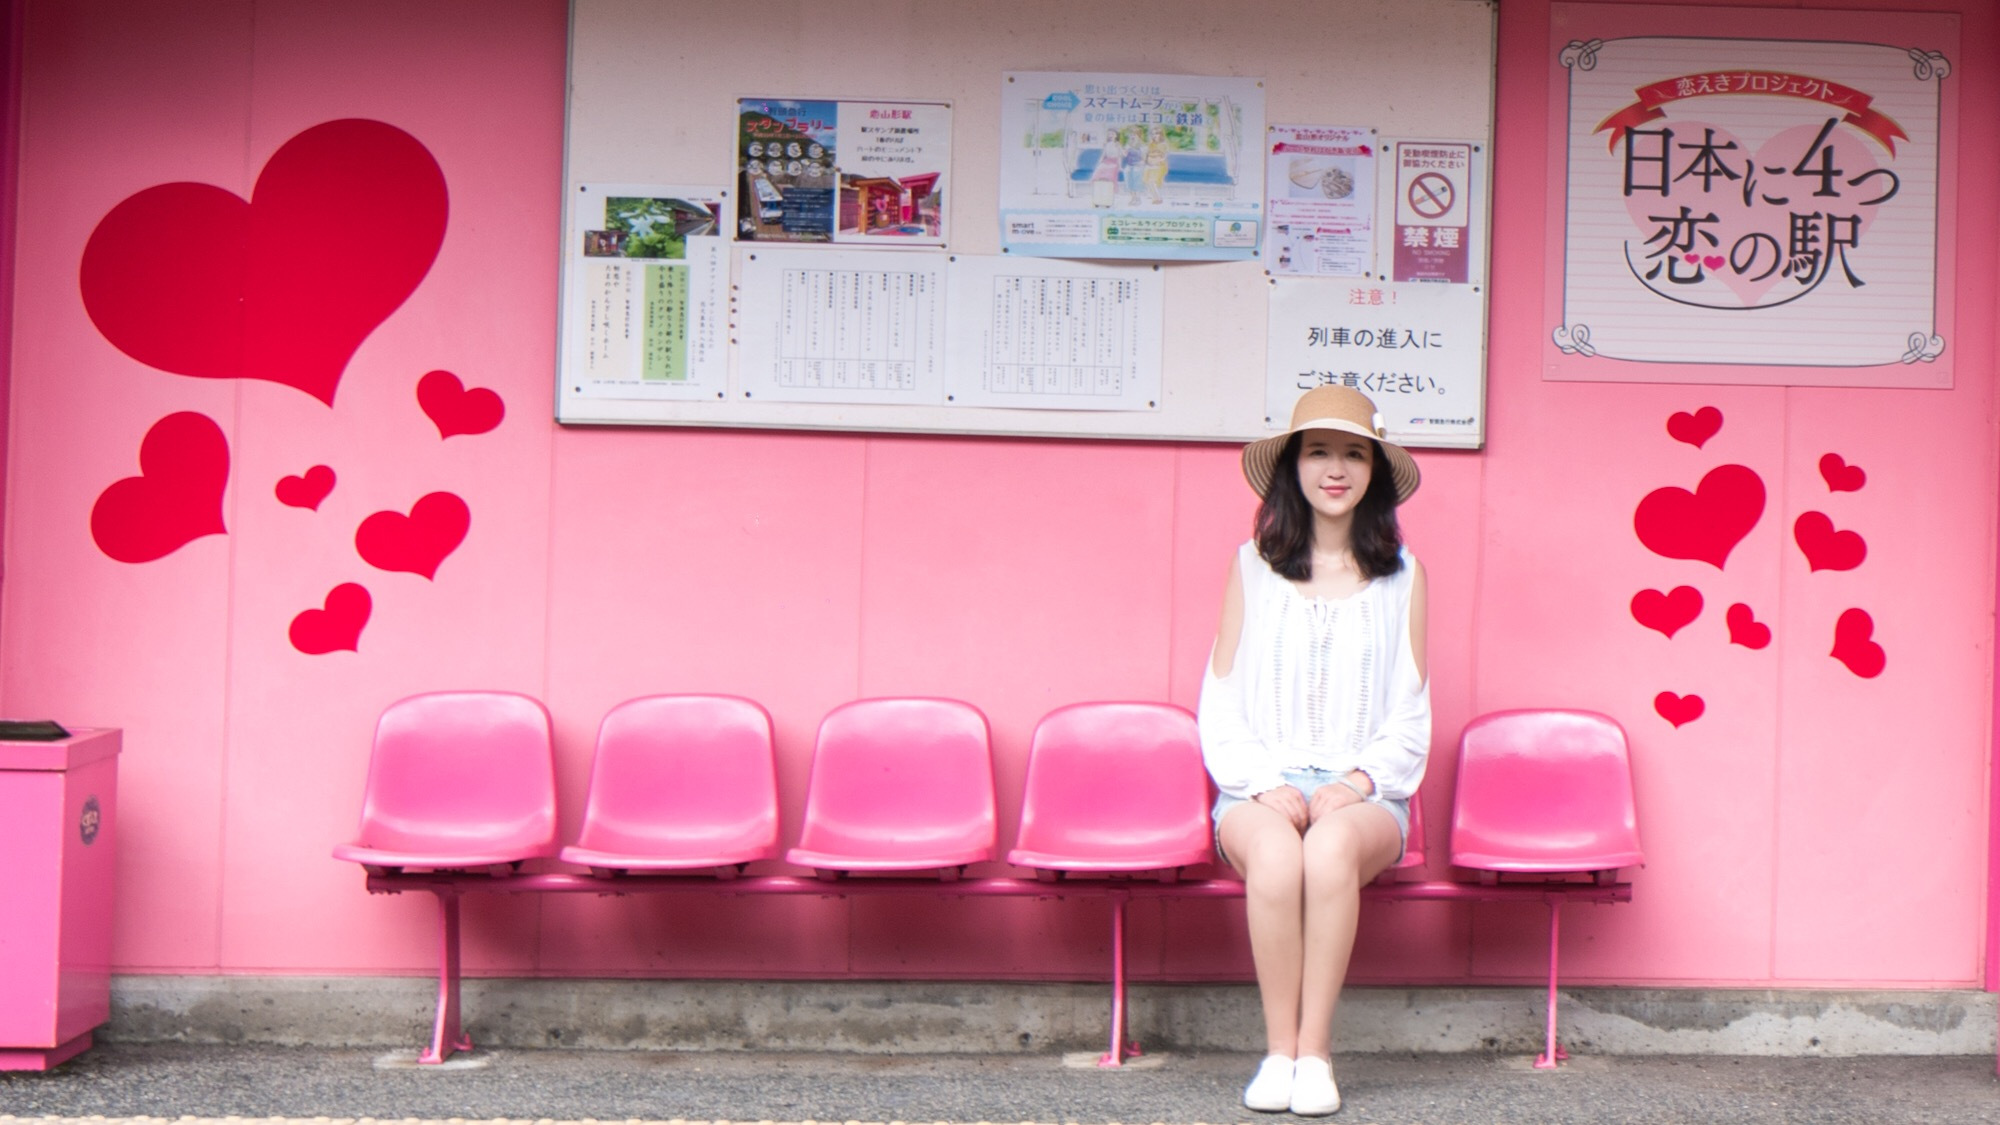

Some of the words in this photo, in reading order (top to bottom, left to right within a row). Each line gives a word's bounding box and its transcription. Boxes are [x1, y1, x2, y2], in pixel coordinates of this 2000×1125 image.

[1084, 83, 1161, 95] 思い出づくりは
[1676, 73, 1835, 100] 恋えきプロジェクト
[746, 117, 836, 133] スタンプラリー
[1403, 149, 1465, 159] 受動喫煙防止に
[1403, 159, 1465, 169] 御協力ください
[1622, 117, 1901, 207] 日本に4つ
[1011, 221, 1035, 229] smart
[1403, 226, 1460, 248] 禁煙
[1643, 206, 1867, 289] 恋の駅
[1348, 288, 1398, 306] 注意！
[1307, 326, 1443, 349] 列車の進入に
[1297, 371, 1447, 395] ご注意ください。
